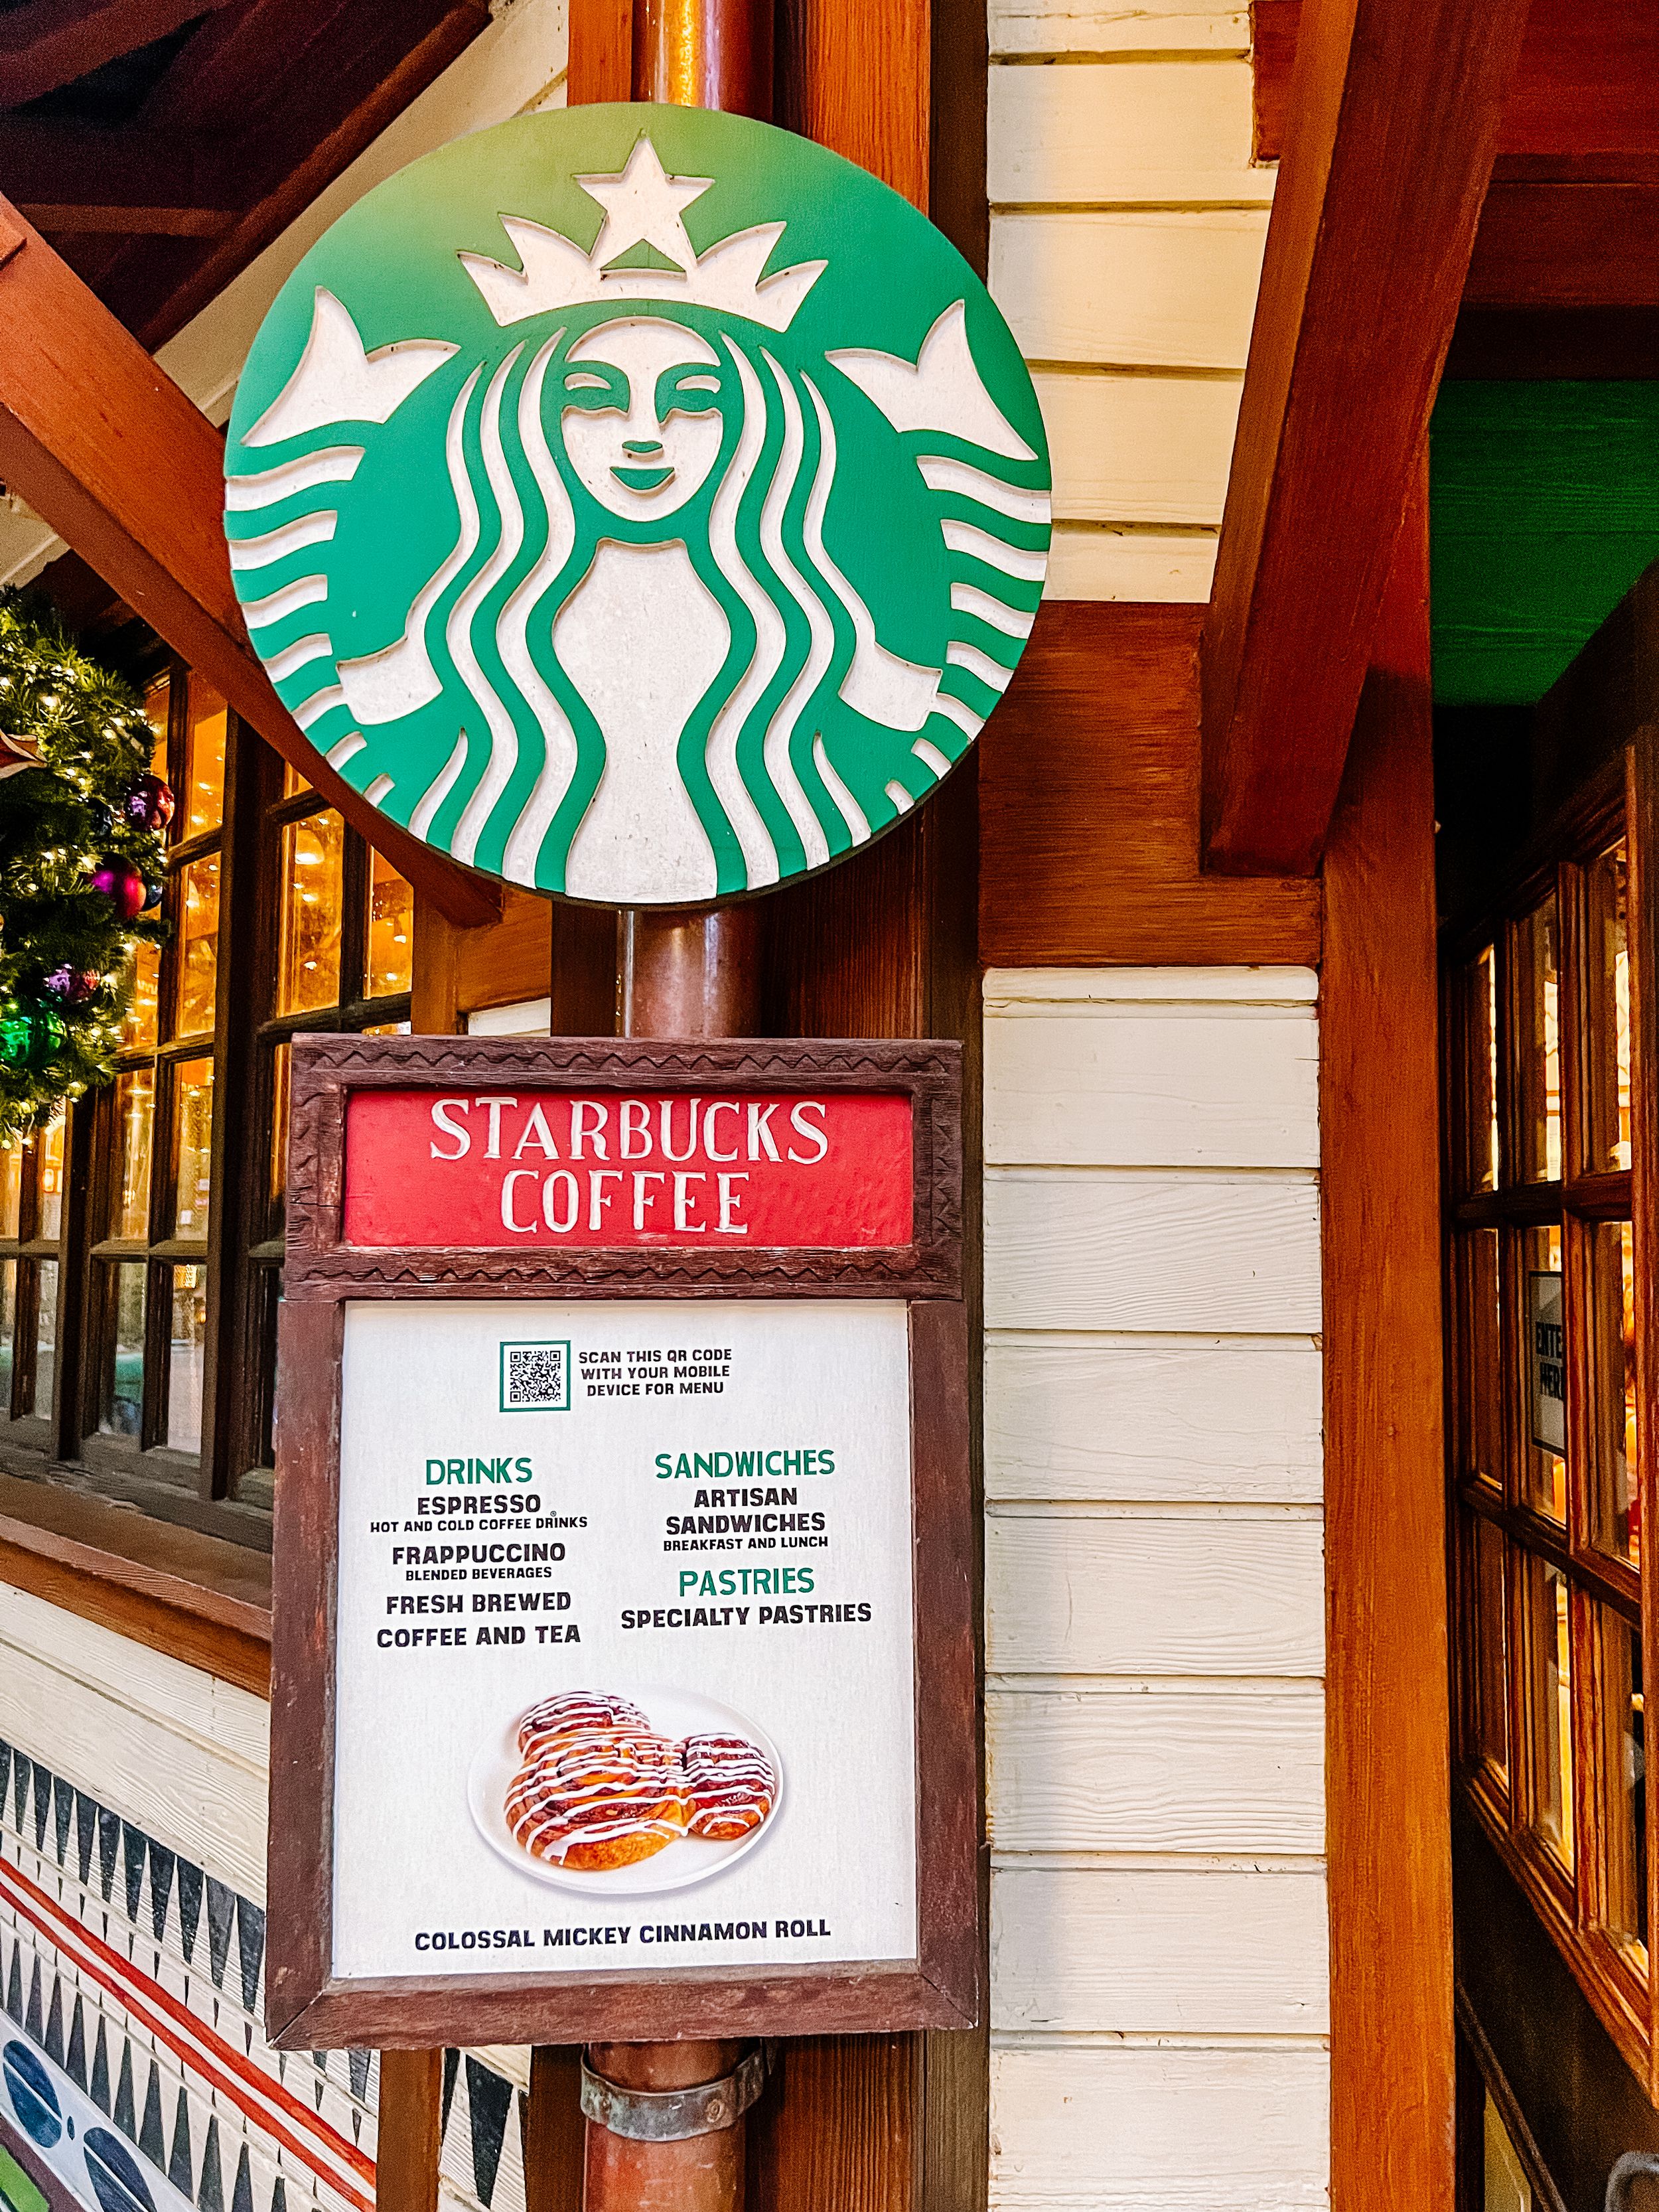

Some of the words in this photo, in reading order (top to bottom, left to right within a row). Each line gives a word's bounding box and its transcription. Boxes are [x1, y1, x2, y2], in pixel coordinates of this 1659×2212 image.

[430, 1096, 828, 1165] STARBUCKS
[501, 1169, 750, 1234] COFFEE
[579, 1351, 621, 1364] SCAN
[626, 1350, 662, 1363] THIS
[667, 1349, 687, 1363] QR
[692, 1349, 732, 1361] CODE
[581, 1368, 622, 1380] WITH
[627, 1366, 668, 1379] YOUR
[674, 1365, 730, 1378] MOBILE
[1540, 1362, 1564, 1400] HER
[587, 1384, 640, 1397] DEVICE
[645, 1383, 674, 1395] FOR
[680, 1382, 723, 1394] MENU
[426, 1457, 532, 1485] DRINKS
[655, 1449, 835, 1479] SANDWICHES
[417, 1494, 541, 1515] ESPRESSO
[693, 1487, 797, 1508] ARTISAN
[370, 1521, 399, 1533] HOT
[403, 1520, 433, 1532] AND
[437, 1519, 474, 1531] COLD
[479, 1518, 532, 1530] COFFEE
[536, 1516, 587, 1529] DRINKS
[666, 1512, 826, 1535] SANDWICHES
[393, 1542, 565, 1565] FRAPPUCCINO
[664, 1538, 743, 1552] BREAKFAST
[747, 1537, 776, 1549] AND
[780, 1536, 828, 1548] LUNCH
[405, 1569, 467, 1581] BLENDED
[472, 1566, 552, 1580] BEVERAGES
[680, 1567, 814, 1597] PASTRIES
[386, 1594, 463, 1615] FRESH
[472, 1591, 571, 1613] BREWED
[621, 1607, 750, 1629] SPECIALTY
[759, 1603, 871, 1625] PASTRIES
[377, 1627, 467, 1648] COFFEE
[476, 1626, 526, 1645] AND
[535, 1624, 581, 1644] TEA
[415, 1930, 536, 1951] COLOSSAL
[543, 1926, 631, 1947] MICKEY
[640, 1921, 767, 1943] CINNAMON
[775, 1919, 831, 1938] ROLL
